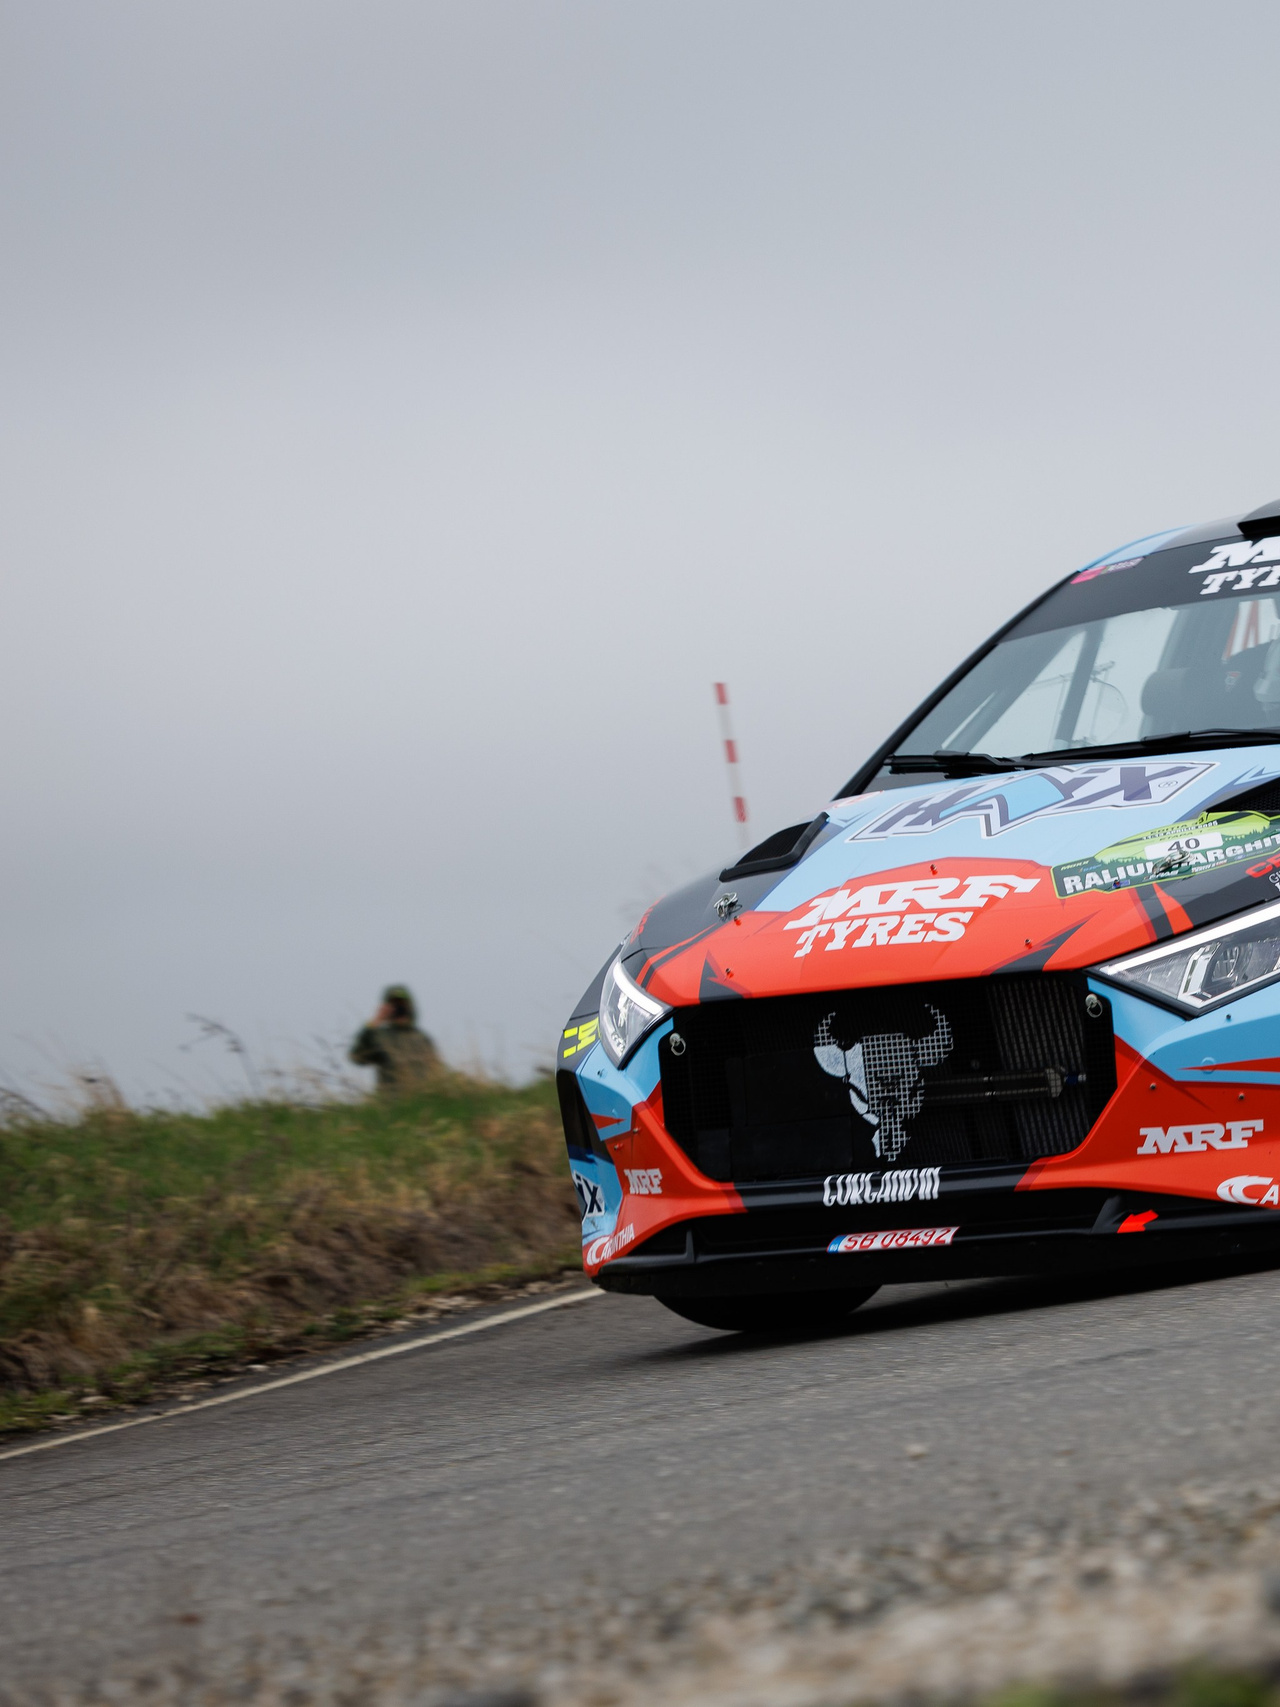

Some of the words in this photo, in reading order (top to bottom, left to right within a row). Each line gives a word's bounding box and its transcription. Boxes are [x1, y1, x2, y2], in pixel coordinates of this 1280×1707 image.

[1168, 837, 1201, 856] 40
[783, 873, 1042, 931] MRF
[793, 911, 973, 958] TYRES
[1137, 1118, 1265, 1156] MRF
[623, 1168, 664, 1195] MRF
[586, 1222, 636, 1266] CARINTHIA
[843, 1233, 879, 1250] SB
[880, 1227, 952, 1248] 08492
